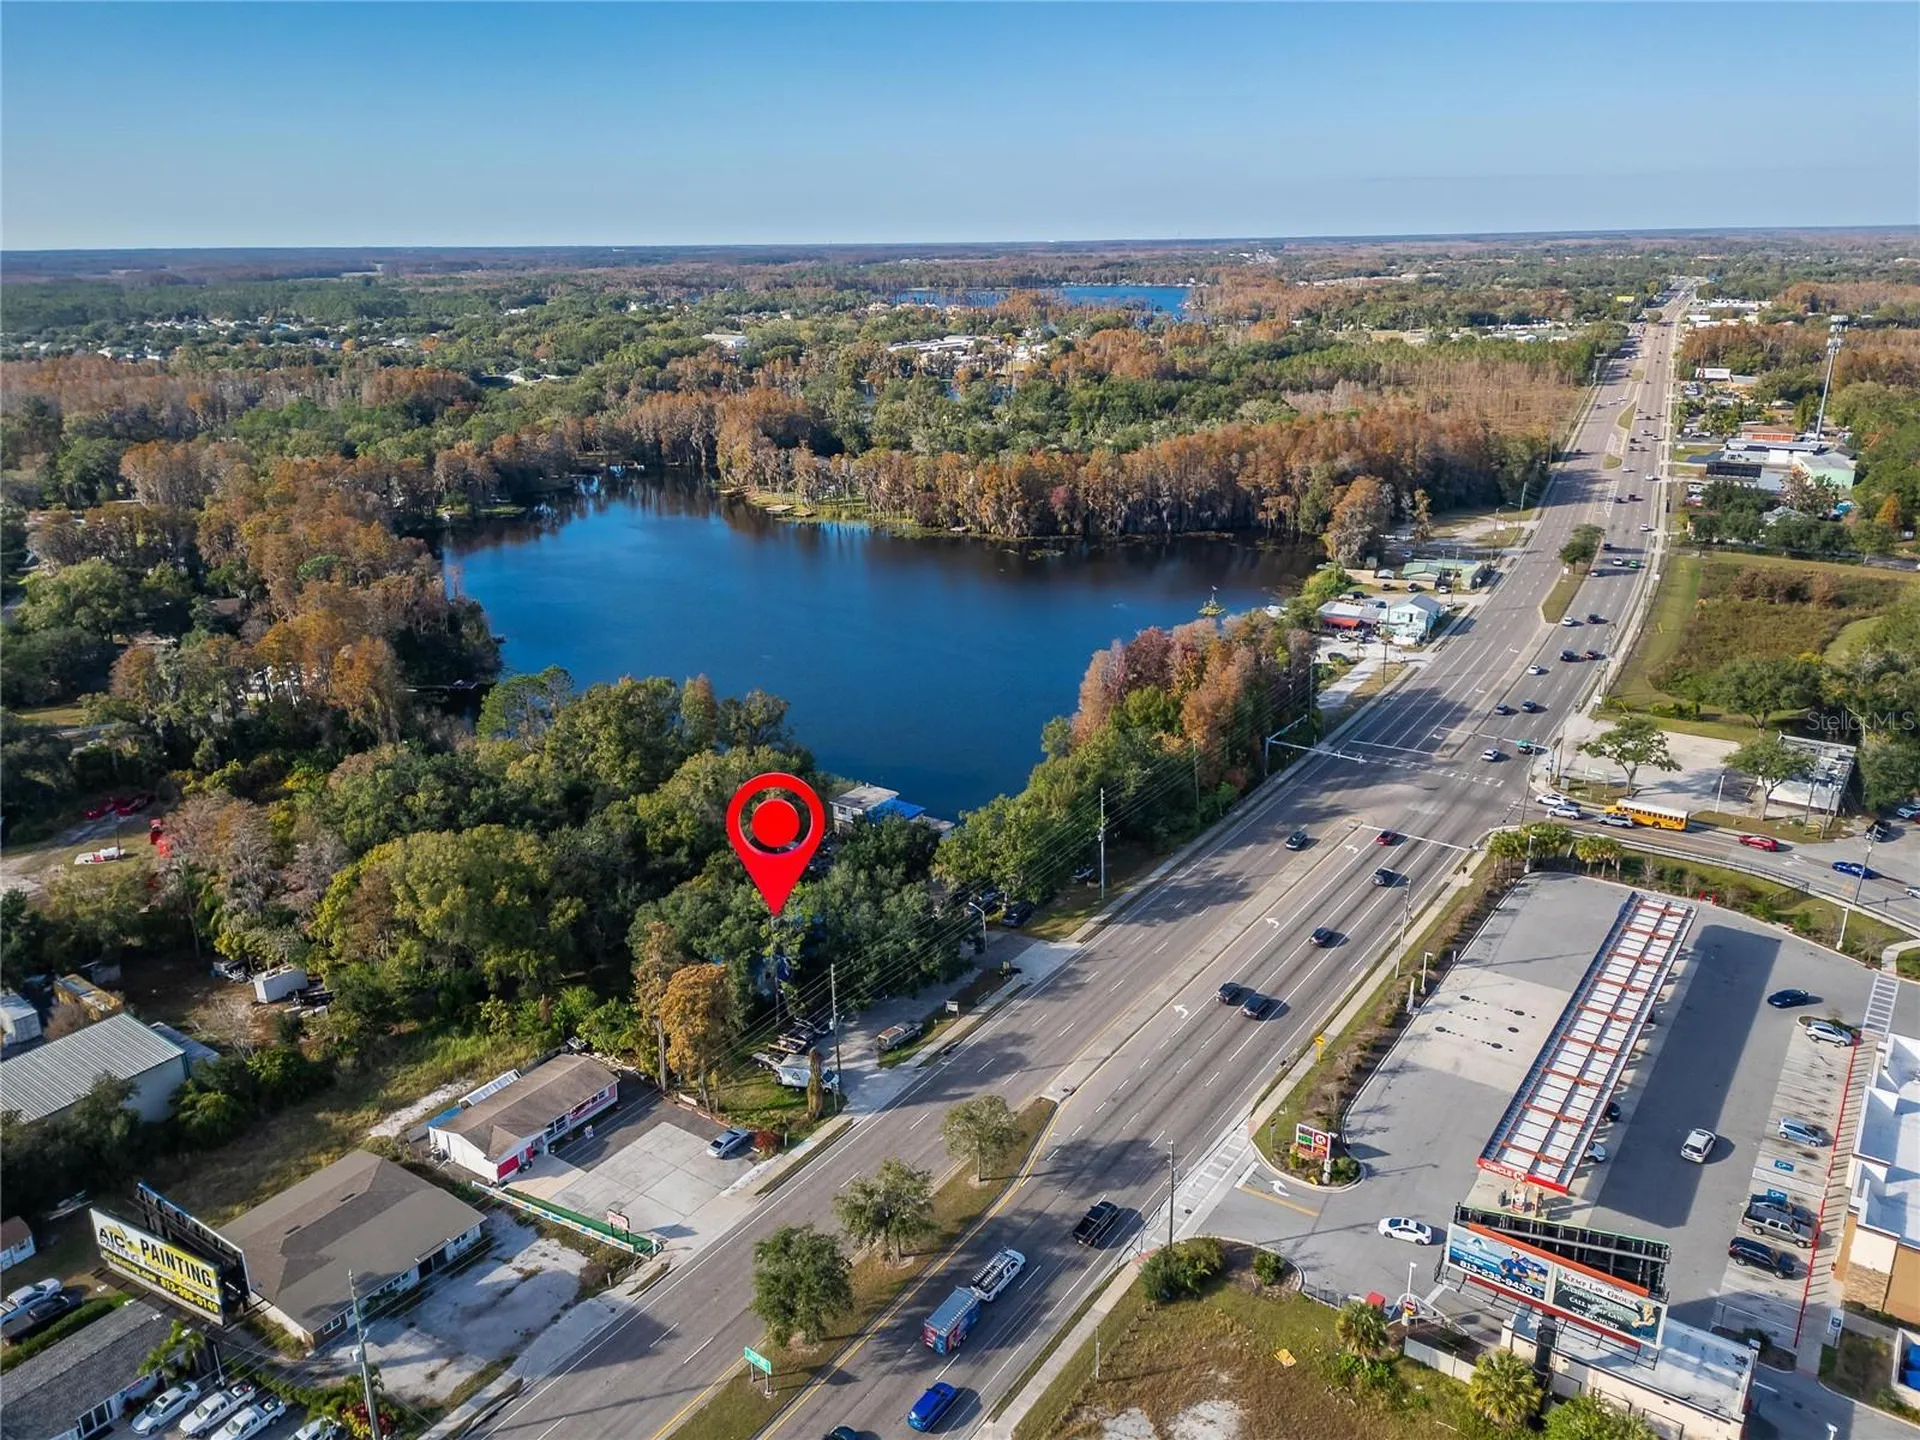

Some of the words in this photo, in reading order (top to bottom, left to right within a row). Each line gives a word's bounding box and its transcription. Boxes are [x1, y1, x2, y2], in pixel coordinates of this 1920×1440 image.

[1483, 1161, 1513, 1178] CIRCLE
[140, 1238, 213, 1290] PAINTING
[1460, 1260, 1533, 1294] 813-232-9430
[1564, 1272, 1587, 1287] KEMP
[1589, 1282, 1606, 1294] LAW
[1607, 1289, 1635, 1306] GROUP
[1569, 1296, 1587, 1307] CALL
